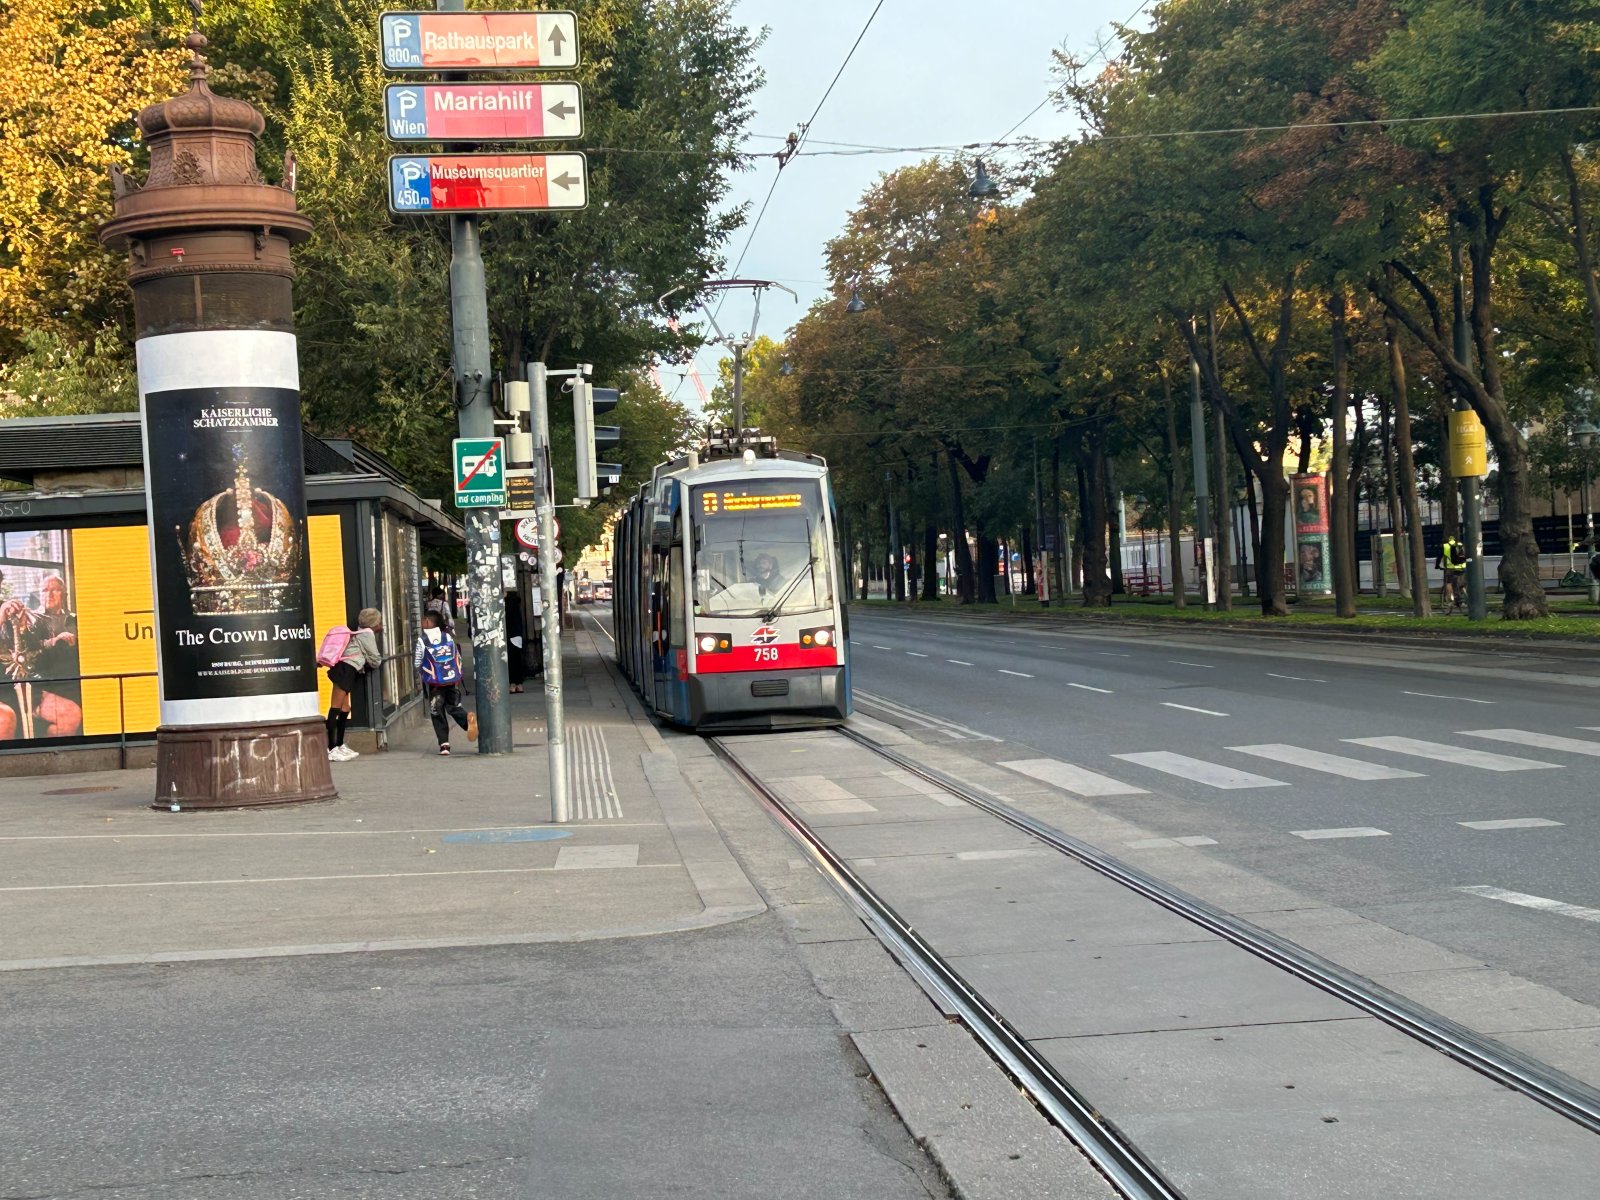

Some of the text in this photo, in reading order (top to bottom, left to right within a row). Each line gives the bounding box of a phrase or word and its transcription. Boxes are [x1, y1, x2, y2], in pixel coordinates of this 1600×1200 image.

[394, 25, 412, 46] P
[424, 31, 535, 53] Rathauspark
[399, 96, 417, 118] P
[433, 90, 533, 111] Mariahilf
[392, 119, 426, 135] Wien
[403, 167, 421, 189] P
[431, 164, 545, 180] Museumsquartier
[201, 408, 273, 418] KAISERLICHE
[193, 418, 279, 428] SCHATZKAMMER
[470, 493, 504, 504] camping
[175, 623, 312, 646] The Crown Jewels
[753, 647, 779, 662] 758
